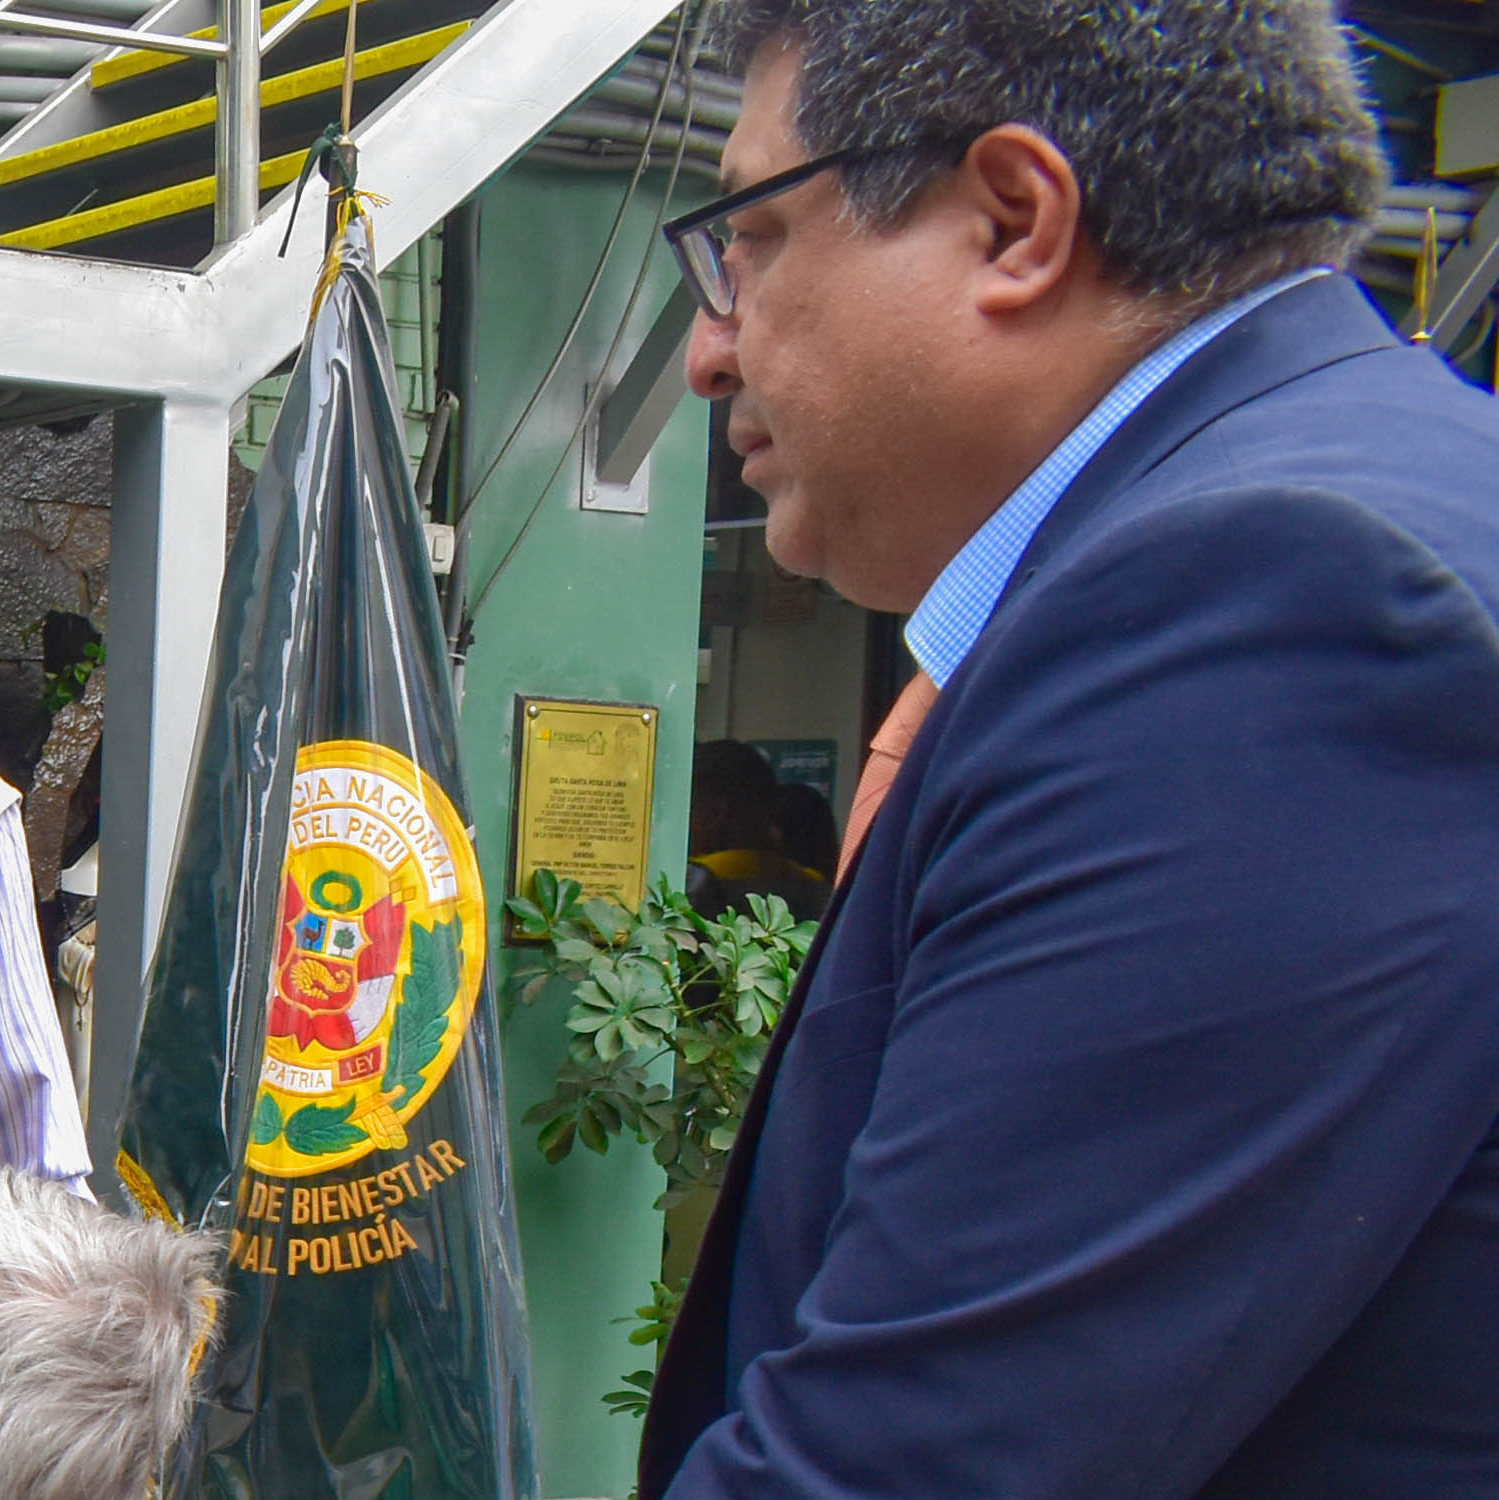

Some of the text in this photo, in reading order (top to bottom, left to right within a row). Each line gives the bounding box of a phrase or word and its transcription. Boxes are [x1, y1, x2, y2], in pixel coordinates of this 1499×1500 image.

[291, 814, 406, 863] DEL PERU
[347, 775, 454, 889] NACIONAL
[263, 1052, 376, 1088] PATRIA LEY
[247, 1181, 286, 1223] DE
[291, 1139, 467, 1225] BIENESTAR
[287, 1213, 419, 1276] POLICÍA
